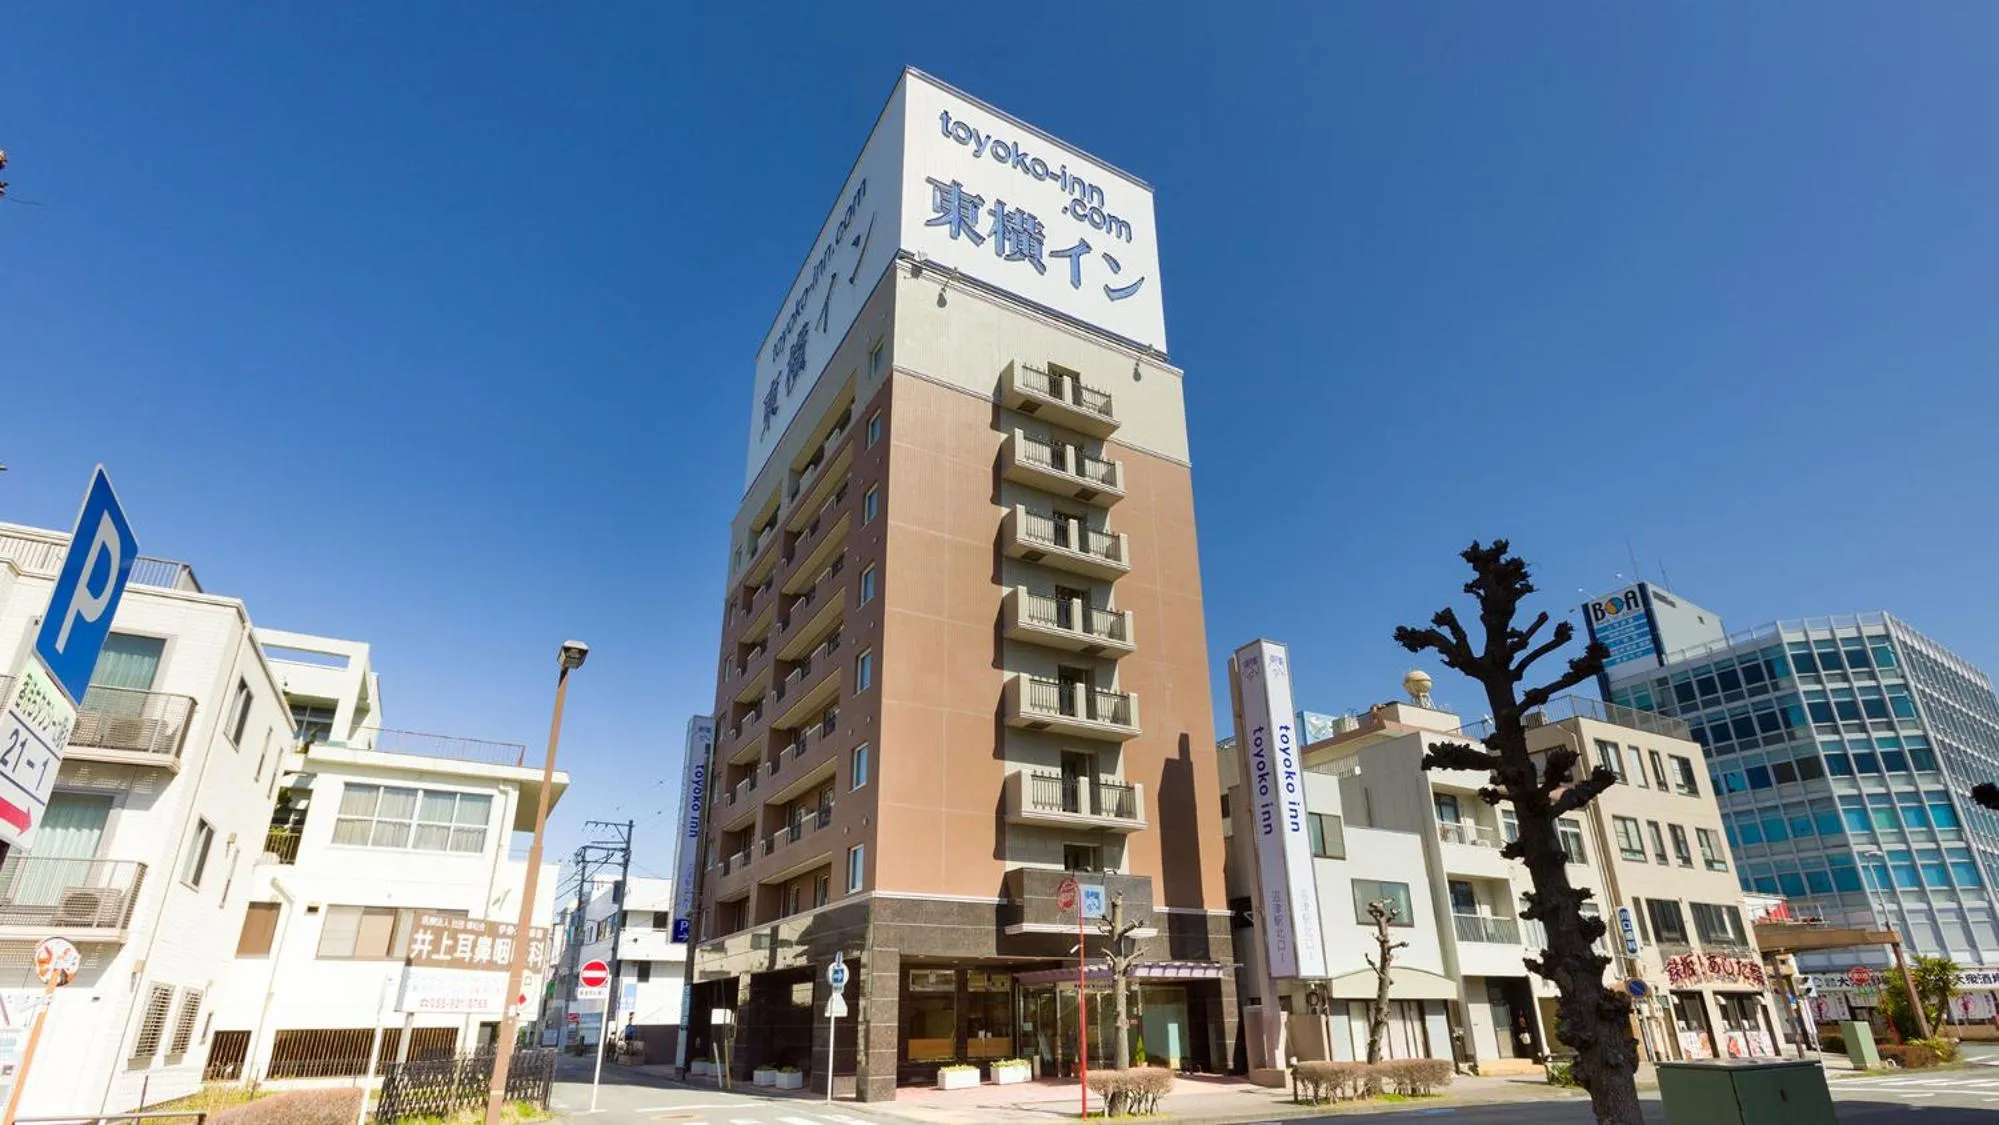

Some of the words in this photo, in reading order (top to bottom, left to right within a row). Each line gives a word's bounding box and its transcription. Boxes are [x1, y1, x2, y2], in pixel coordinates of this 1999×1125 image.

[939, 110, 1105, 208] toyoko-inn
[924, 175, 1145, 302] 東横イン
[1061, 198, 1133, 244] .com
[55, 509, 121, 655] P
[1592, 590, 1640, 622] BOA
[1253, 725, 1270, 796] toyoko
[1279, 724, 1296, 794] toyoko
[1288, 801, 1301, 832] inn
[690, 764, 705, 813] toyoko
[688, 813, 699, 838] inn
[1261, 802, 1274, 835] inn
[410, 928, 545, 968] 井上耳鼻咽科
